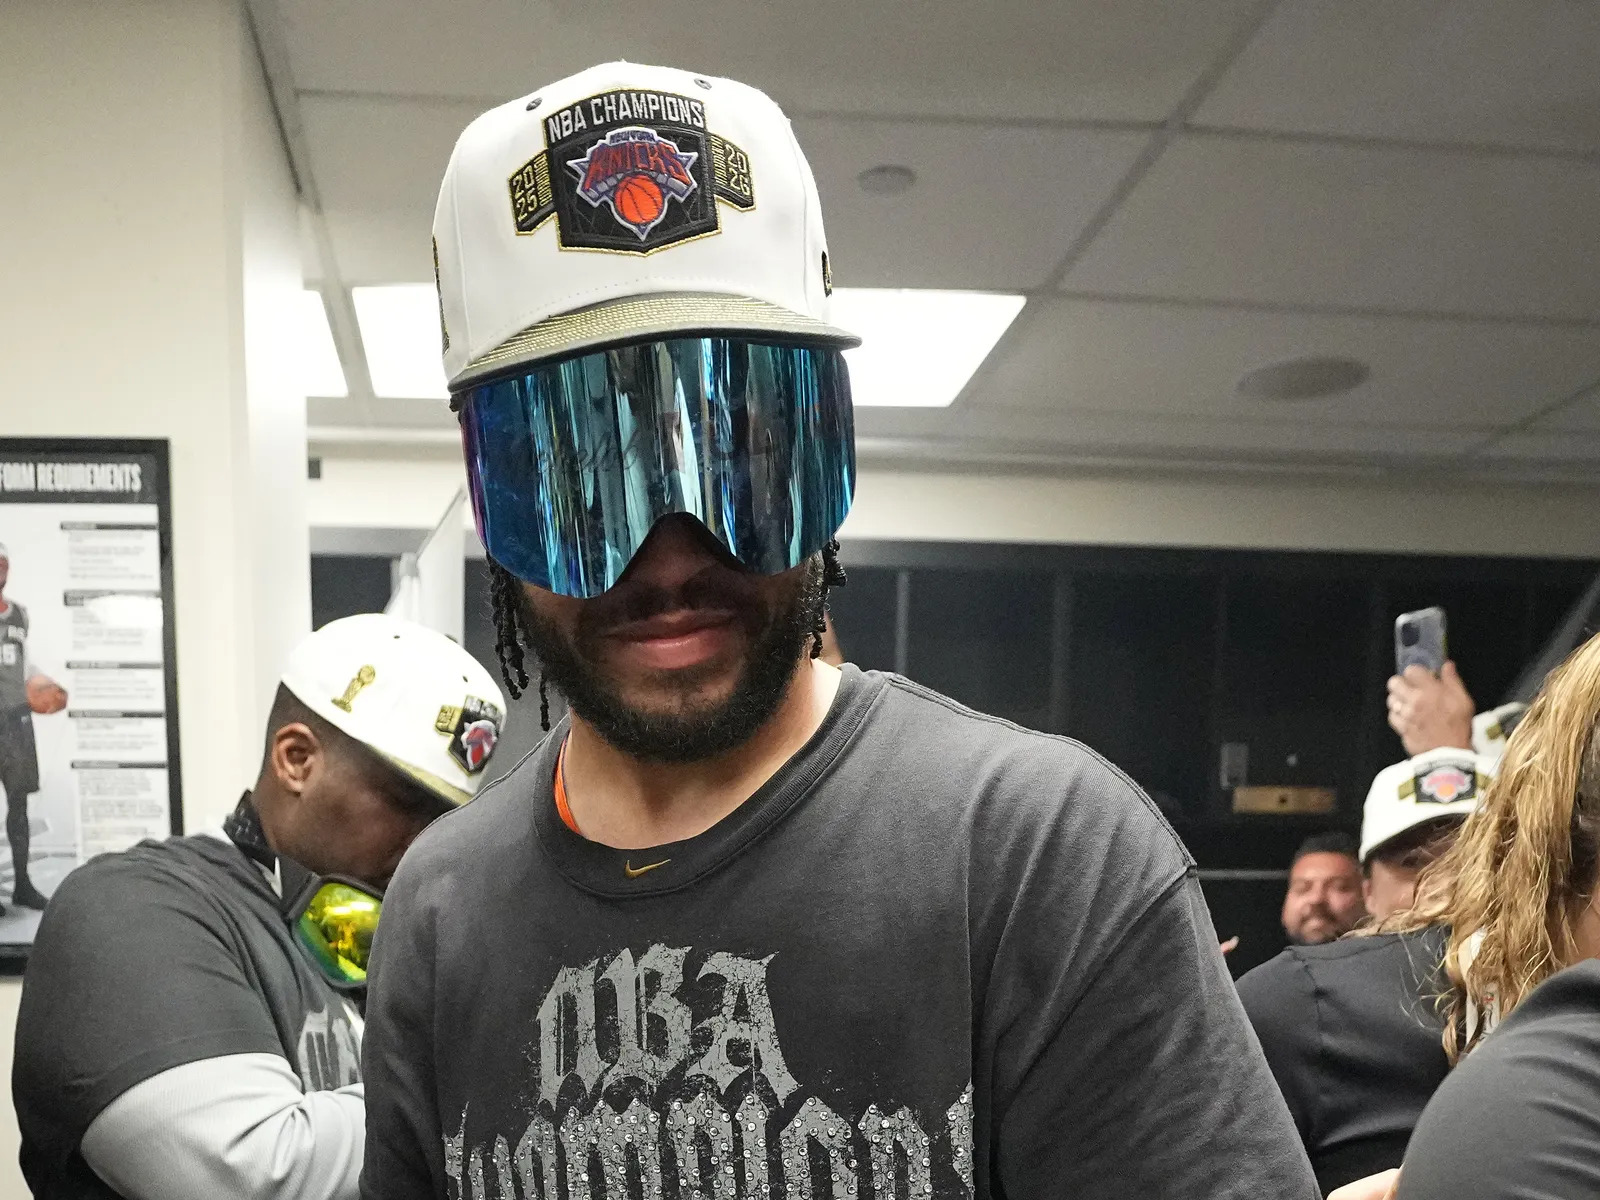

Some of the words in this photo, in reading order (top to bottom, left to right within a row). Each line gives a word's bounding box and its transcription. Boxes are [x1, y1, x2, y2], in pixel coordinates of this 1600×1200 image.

[548, 105, 588, 143] NBA
[590, 92, 705, 129] CHAMPIONS
[584, 141, 692, 191] KNICKS
[724, 143, 748, 173] 20
[512, 164, 536, 199] 20
[728, 167, 751, 195] 26
[516, 187, 538, 222] 25
[536, 943, 803, 1109] NBA
